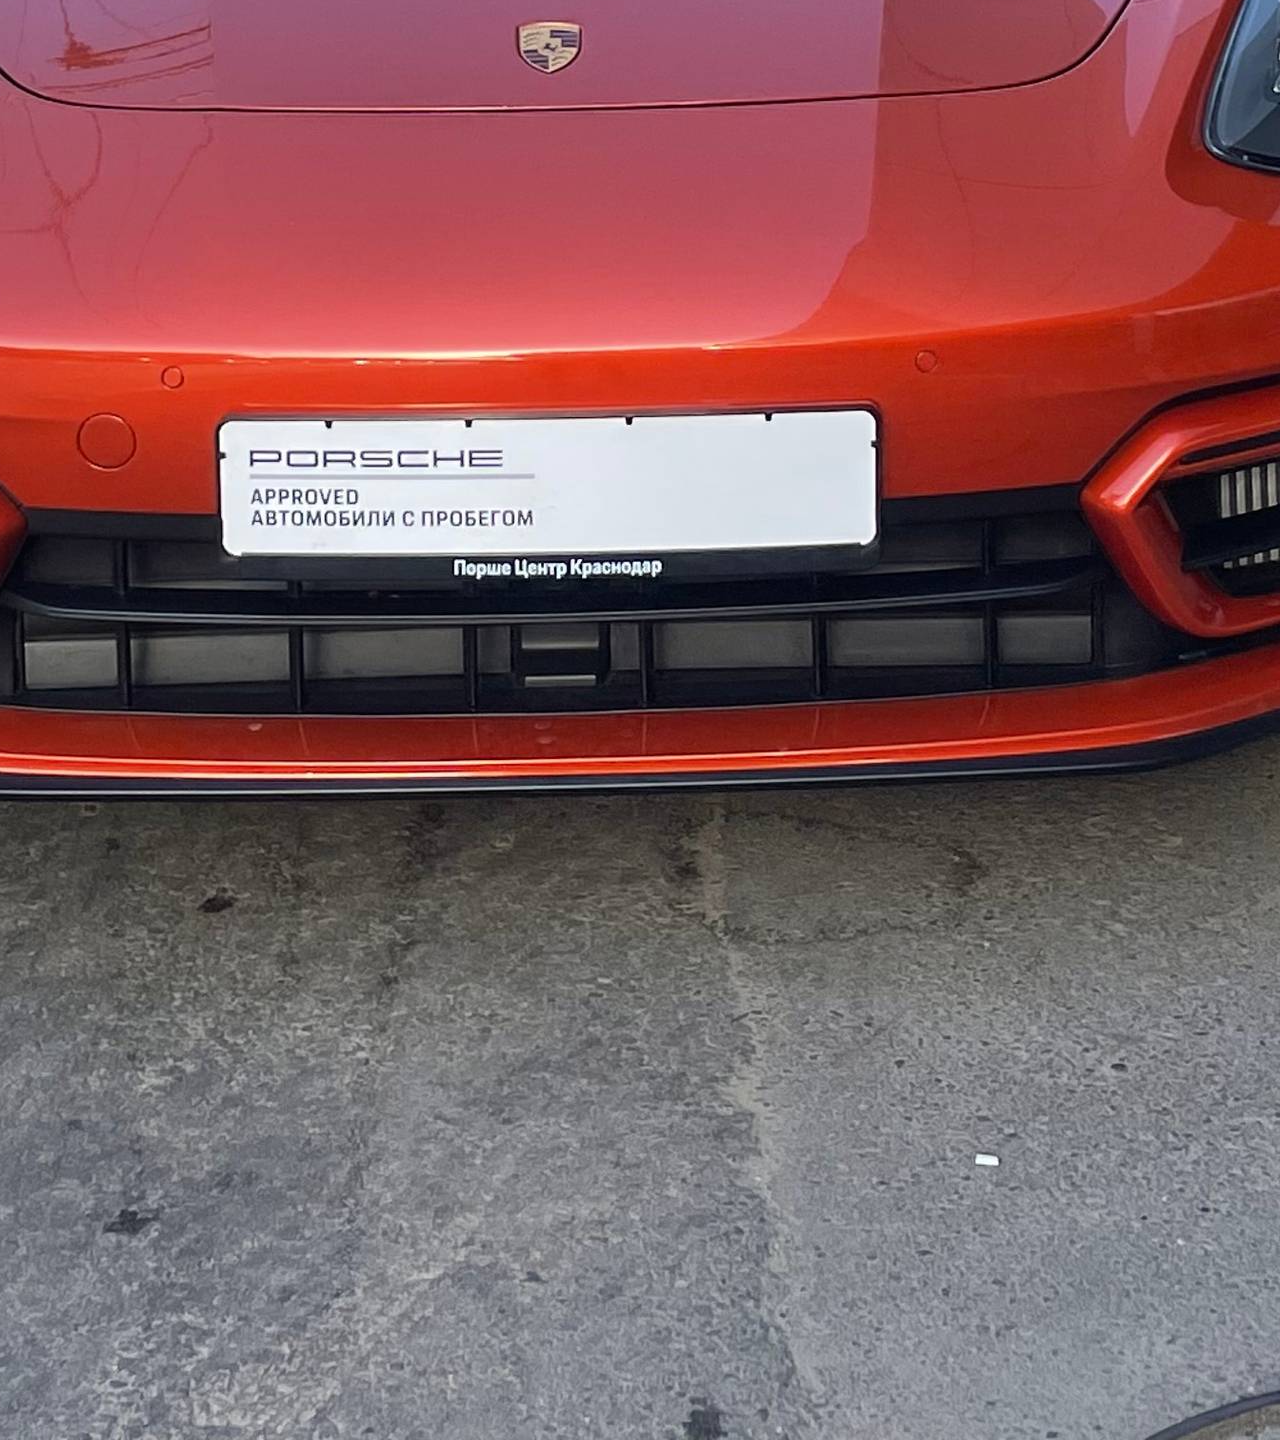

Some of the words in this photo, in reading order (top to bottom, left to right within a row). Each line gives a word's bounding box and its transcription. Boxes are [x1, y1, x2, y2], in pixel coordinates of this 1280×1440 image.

[249, 449, 504, 468] PORSCHE
[250, 488, 359, 506] APPROVED
[250, 509, 396, 528] АВТОМОБИЛИ
[402, 509, 416, 528] С
[421, 509, 535, 528] ПРОБЕГОМ
[453, 558, 512, 580] Порше
[514, 558, 567, 580] Центр
[569, 557, 663, 580] Краснодар
